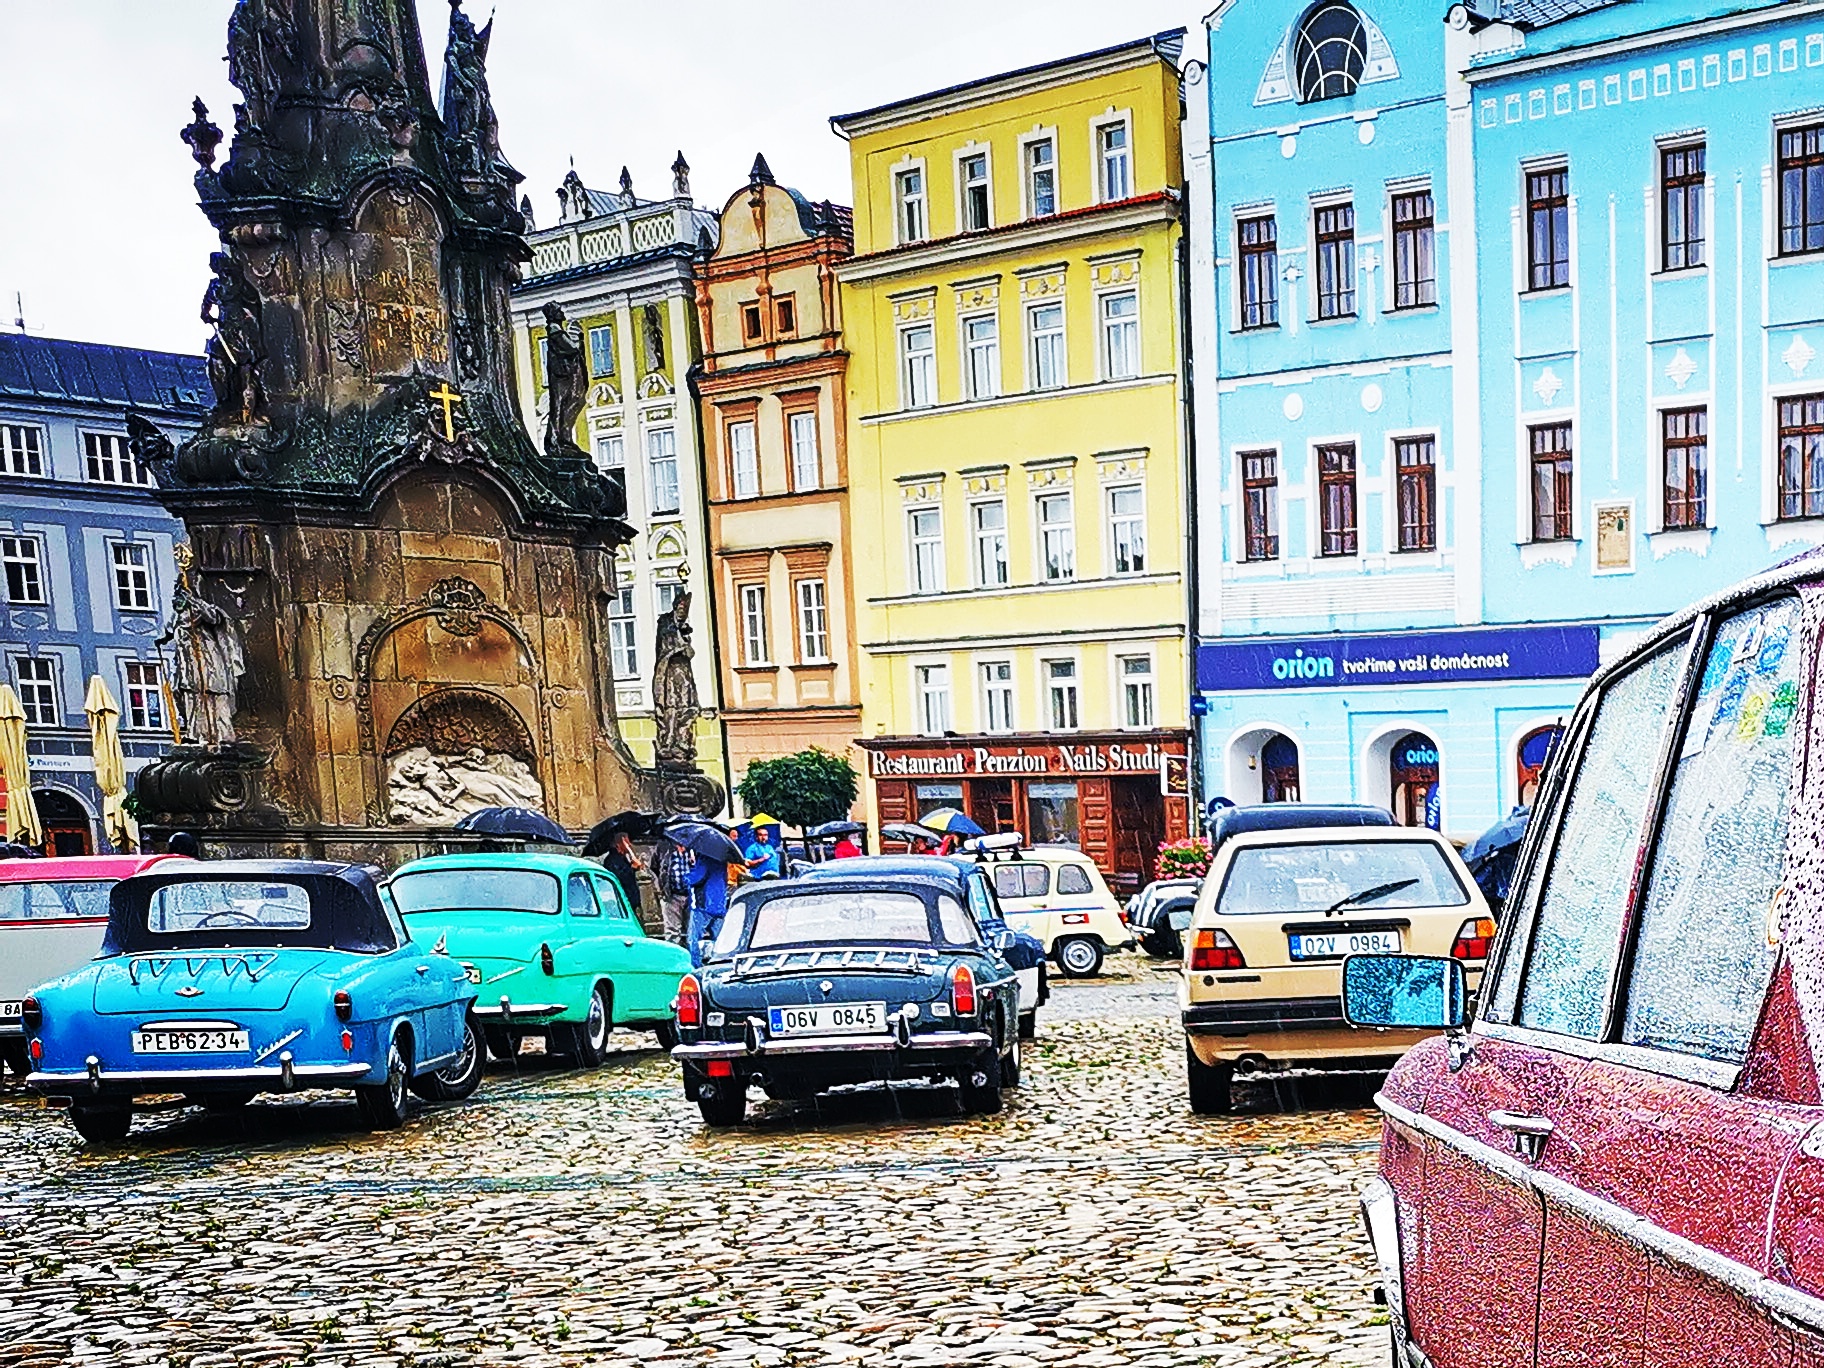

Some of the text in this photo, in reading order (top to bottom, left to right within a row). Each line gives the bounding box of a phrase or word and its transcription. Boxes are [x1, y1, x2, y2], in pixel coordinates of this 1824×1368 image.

[1273, 648, 1334, 679] orion
[1430, 652, 1509, 671] domácnost
[872, 750, 964, 775] Restaurant
[974, 747, 1047, 773] Penzion
[1058, 745, 1106, 772] Nails
[1305, 934, 1391, 954] 02V 0984
[786, 1011, 818, 1028] 06V
[832, 1007, 876, 1026] 0845
